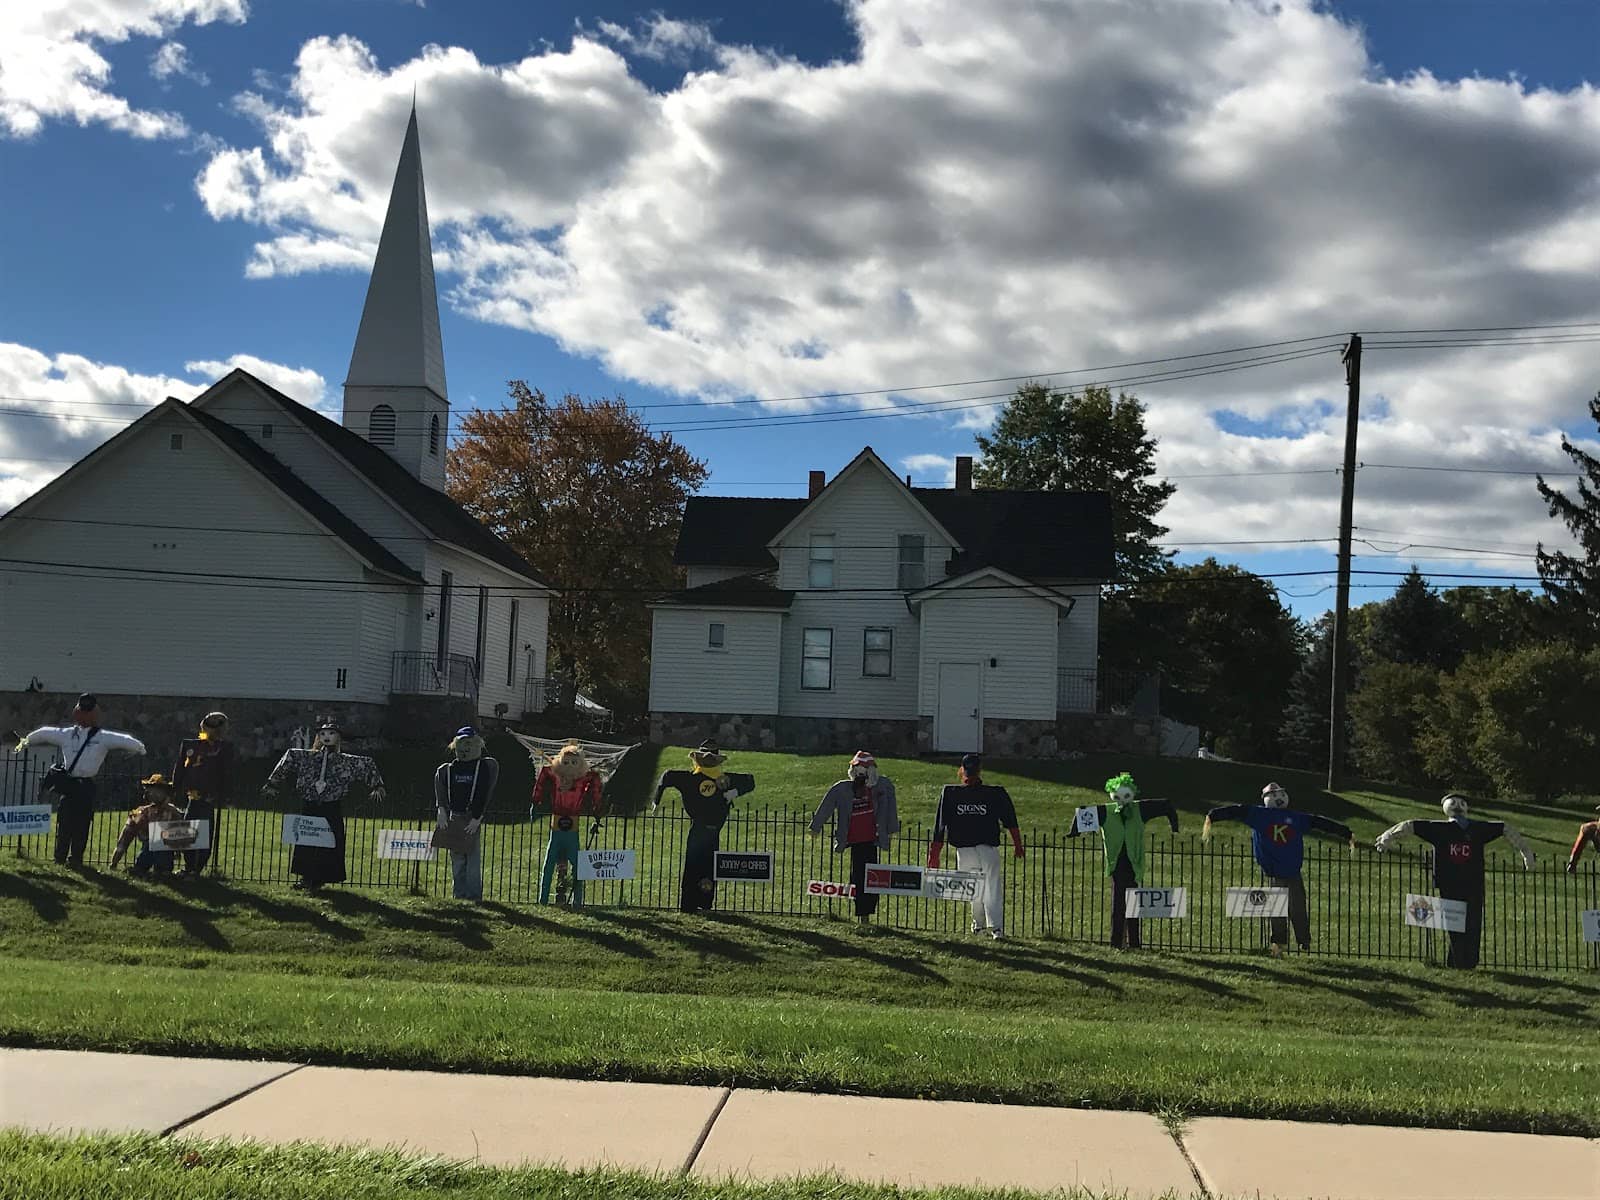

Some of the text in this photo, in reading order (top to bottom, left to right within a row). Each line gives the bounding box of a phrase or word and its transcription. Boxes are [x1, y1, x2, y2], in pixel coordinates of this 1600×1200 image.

[957, 804, 987, 816] SIGNS
[1273, 824, 1288, 843] K
[587, 852, 625, 863] BONEFISH
[596, 869, 615, 878] GRILL
[935, 879, 976, 897] SIGNS
[1134, 890, 1175, 908] TPL
